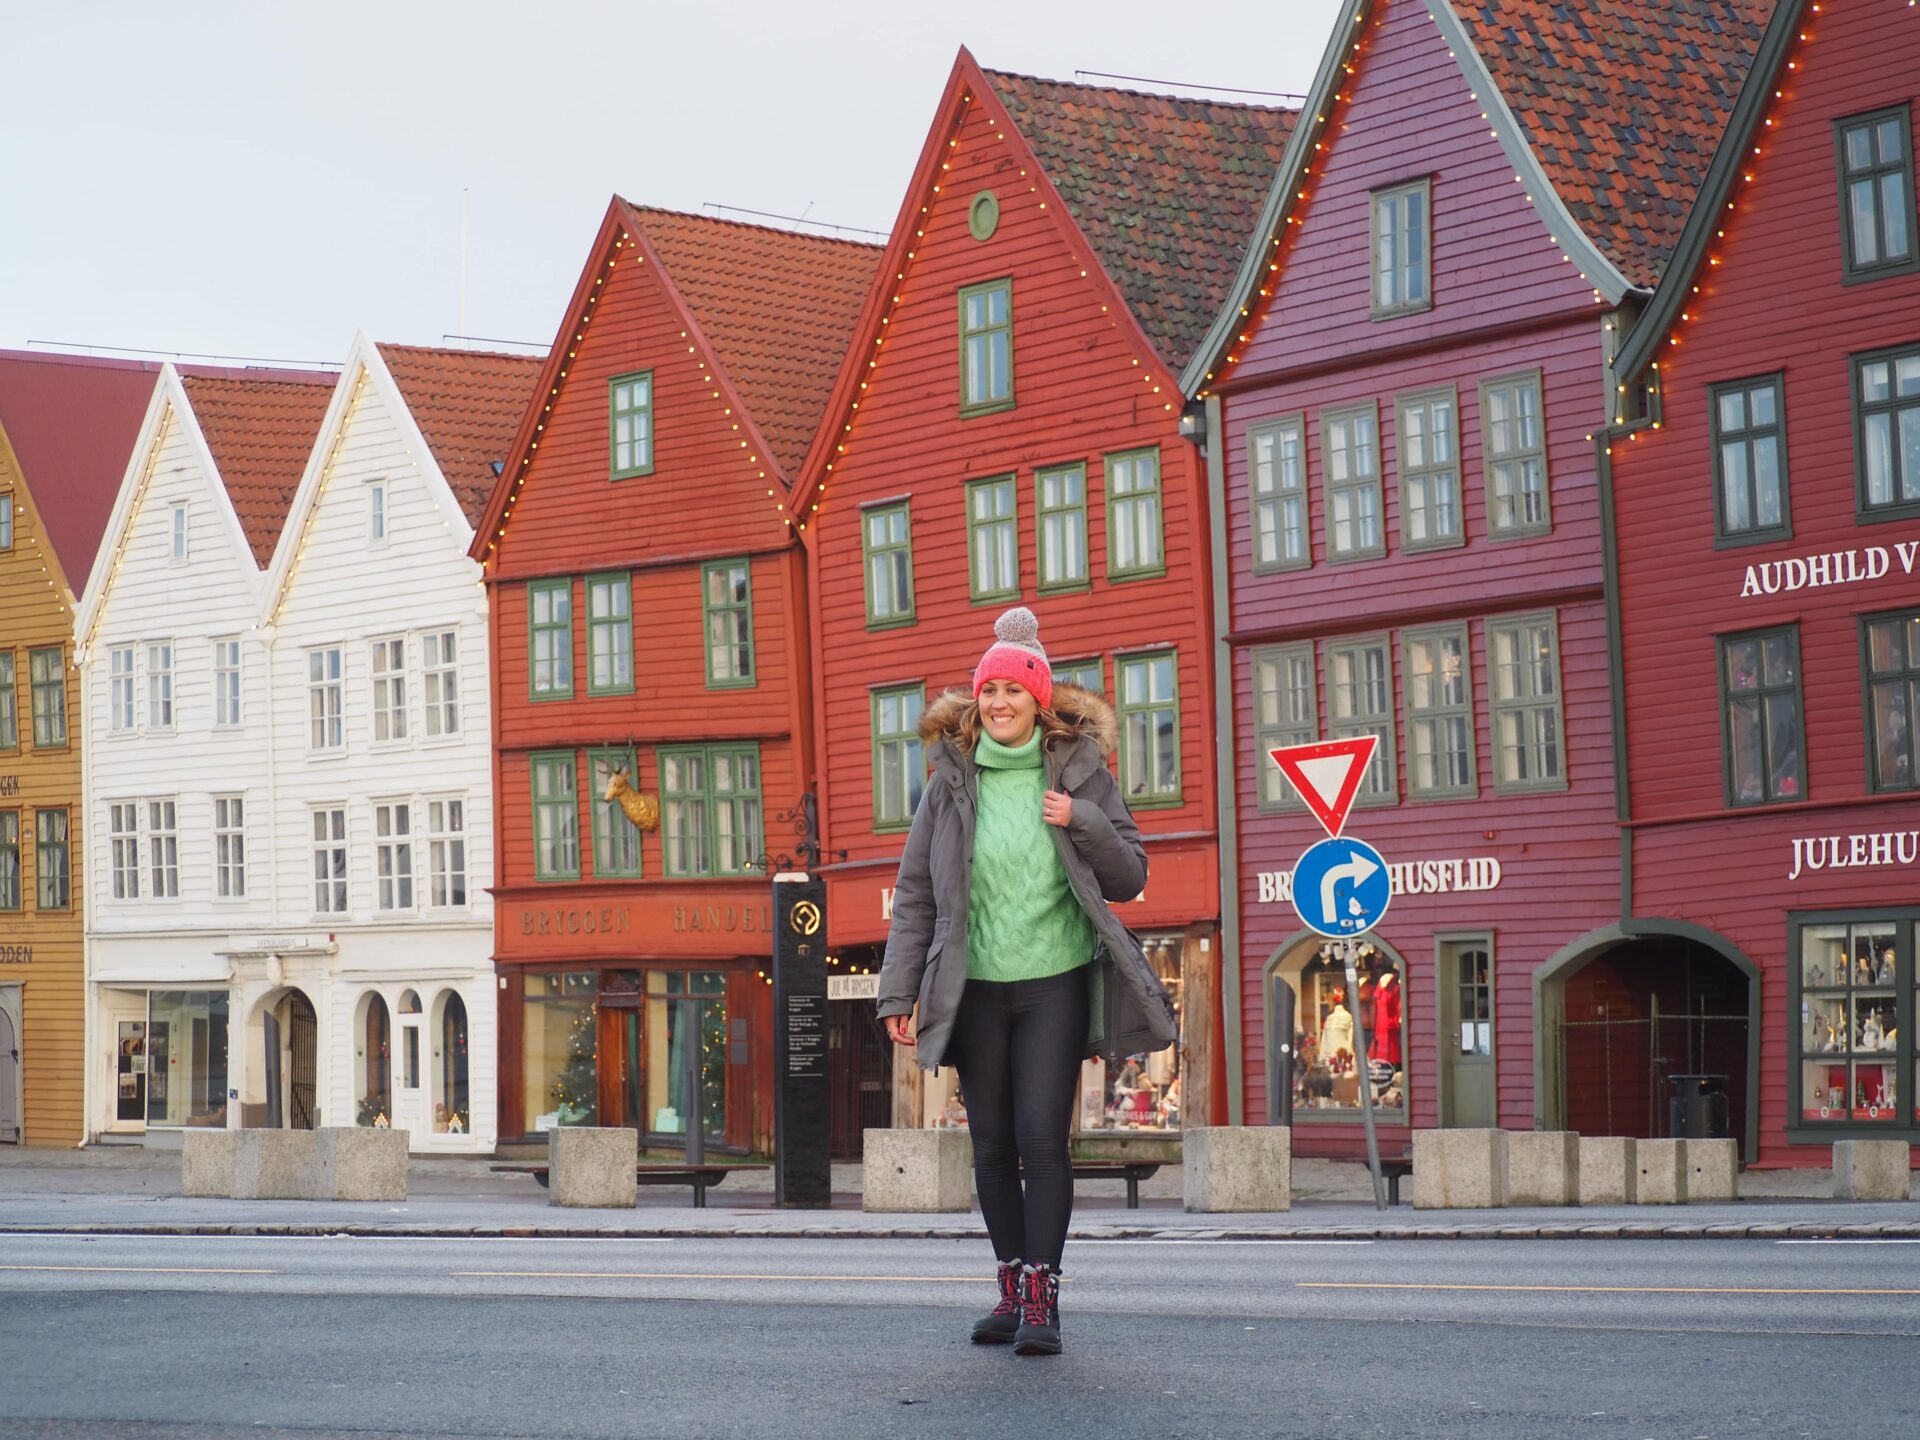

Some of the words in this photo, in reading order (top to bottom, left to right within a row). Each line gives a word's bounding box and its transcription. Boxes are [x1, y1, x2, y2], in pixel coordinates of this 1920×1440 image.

[1740, 546, 1890, 598] AUDHILD
[1389, 857, 1502, 896] HUSFLID
[1788, 831, 1920, 880] JULEHU
[521, 907, 632, 936] BRYGGEN
